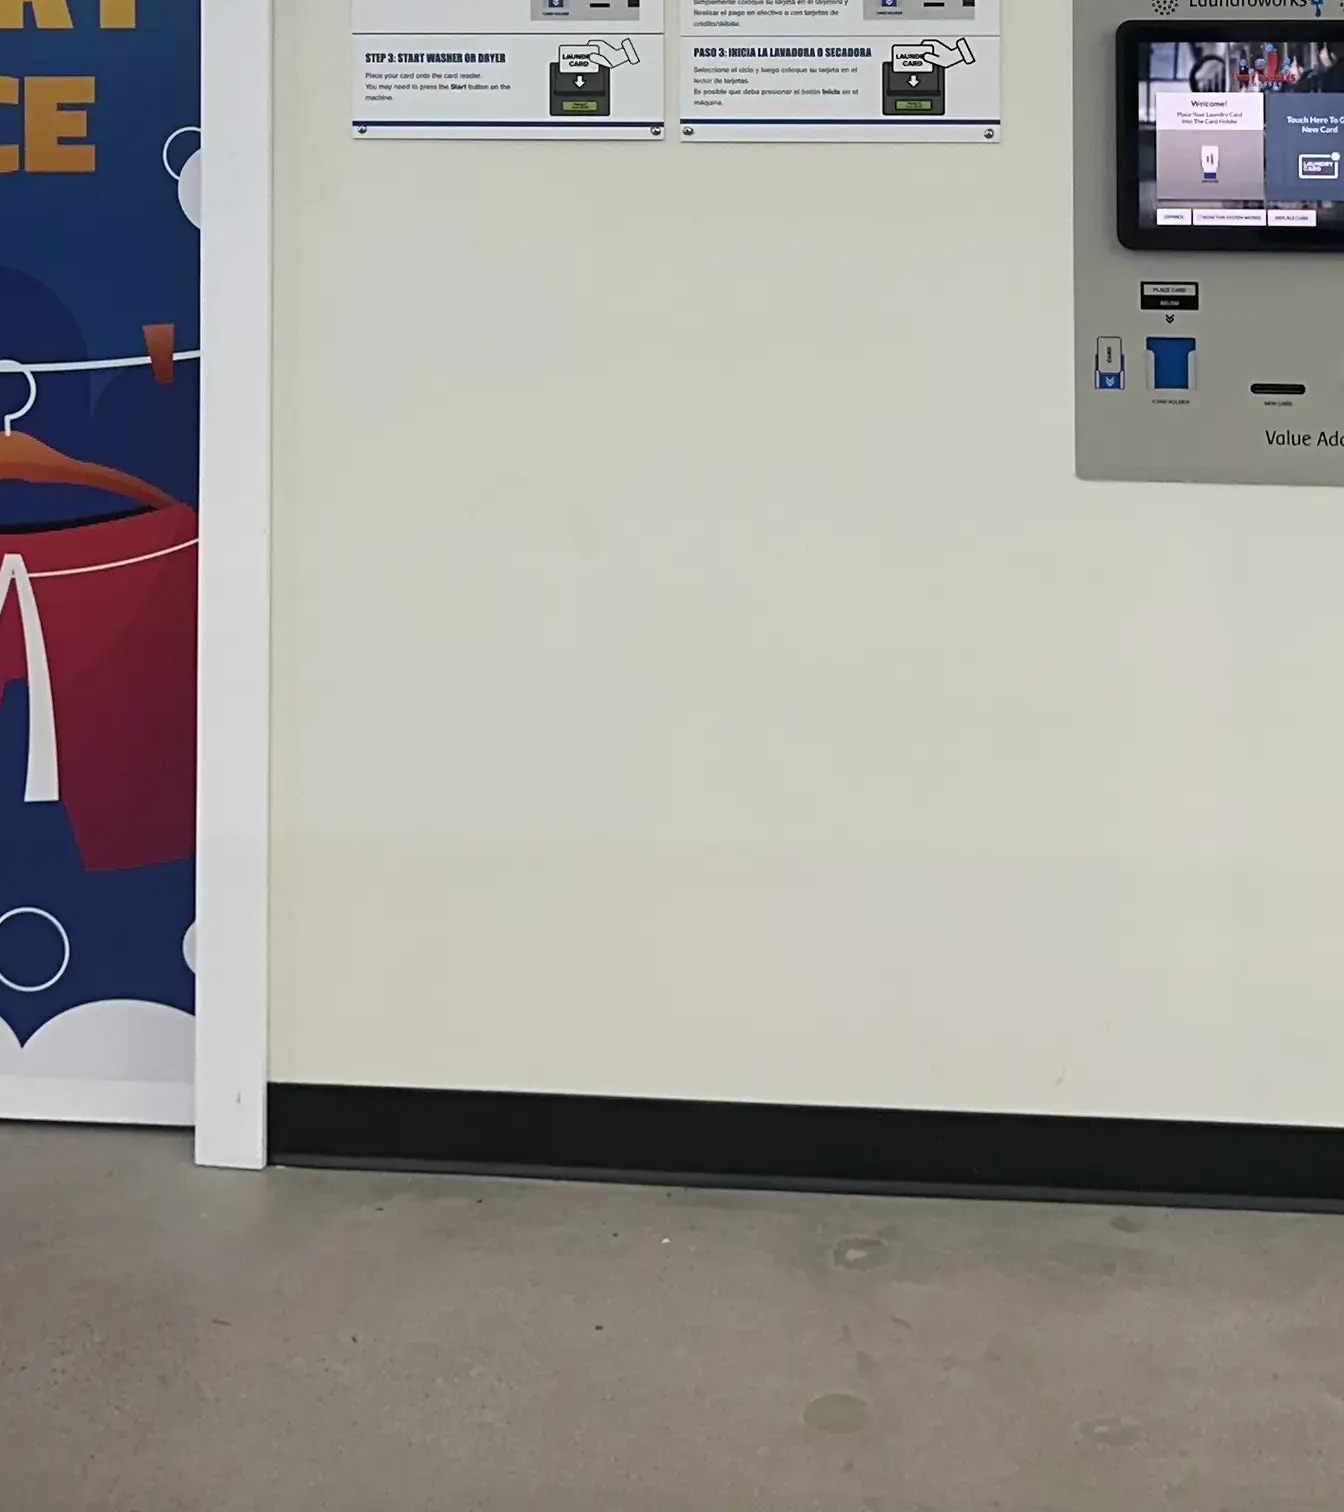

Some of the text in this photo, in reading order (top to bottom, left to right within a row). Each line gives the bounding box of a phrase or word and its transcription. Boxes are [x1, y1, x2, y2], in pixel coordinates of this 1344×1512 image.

[693, 47, 871, 57] PASO 3: INICIA LA LAVADORA O SECADORA
[365, 52, 506, 63] STEP 3: START WASHER OR DRYER
[568, 60, 589, 68] CARD
[1286, 115, 1309, 125] Touch
[1310, 115, 1328, 125] Here
[1330, 115, 1338, 125] To
[1301, 125, 1339, 134] New Card
[1265, 429, 1311, 446] Value
